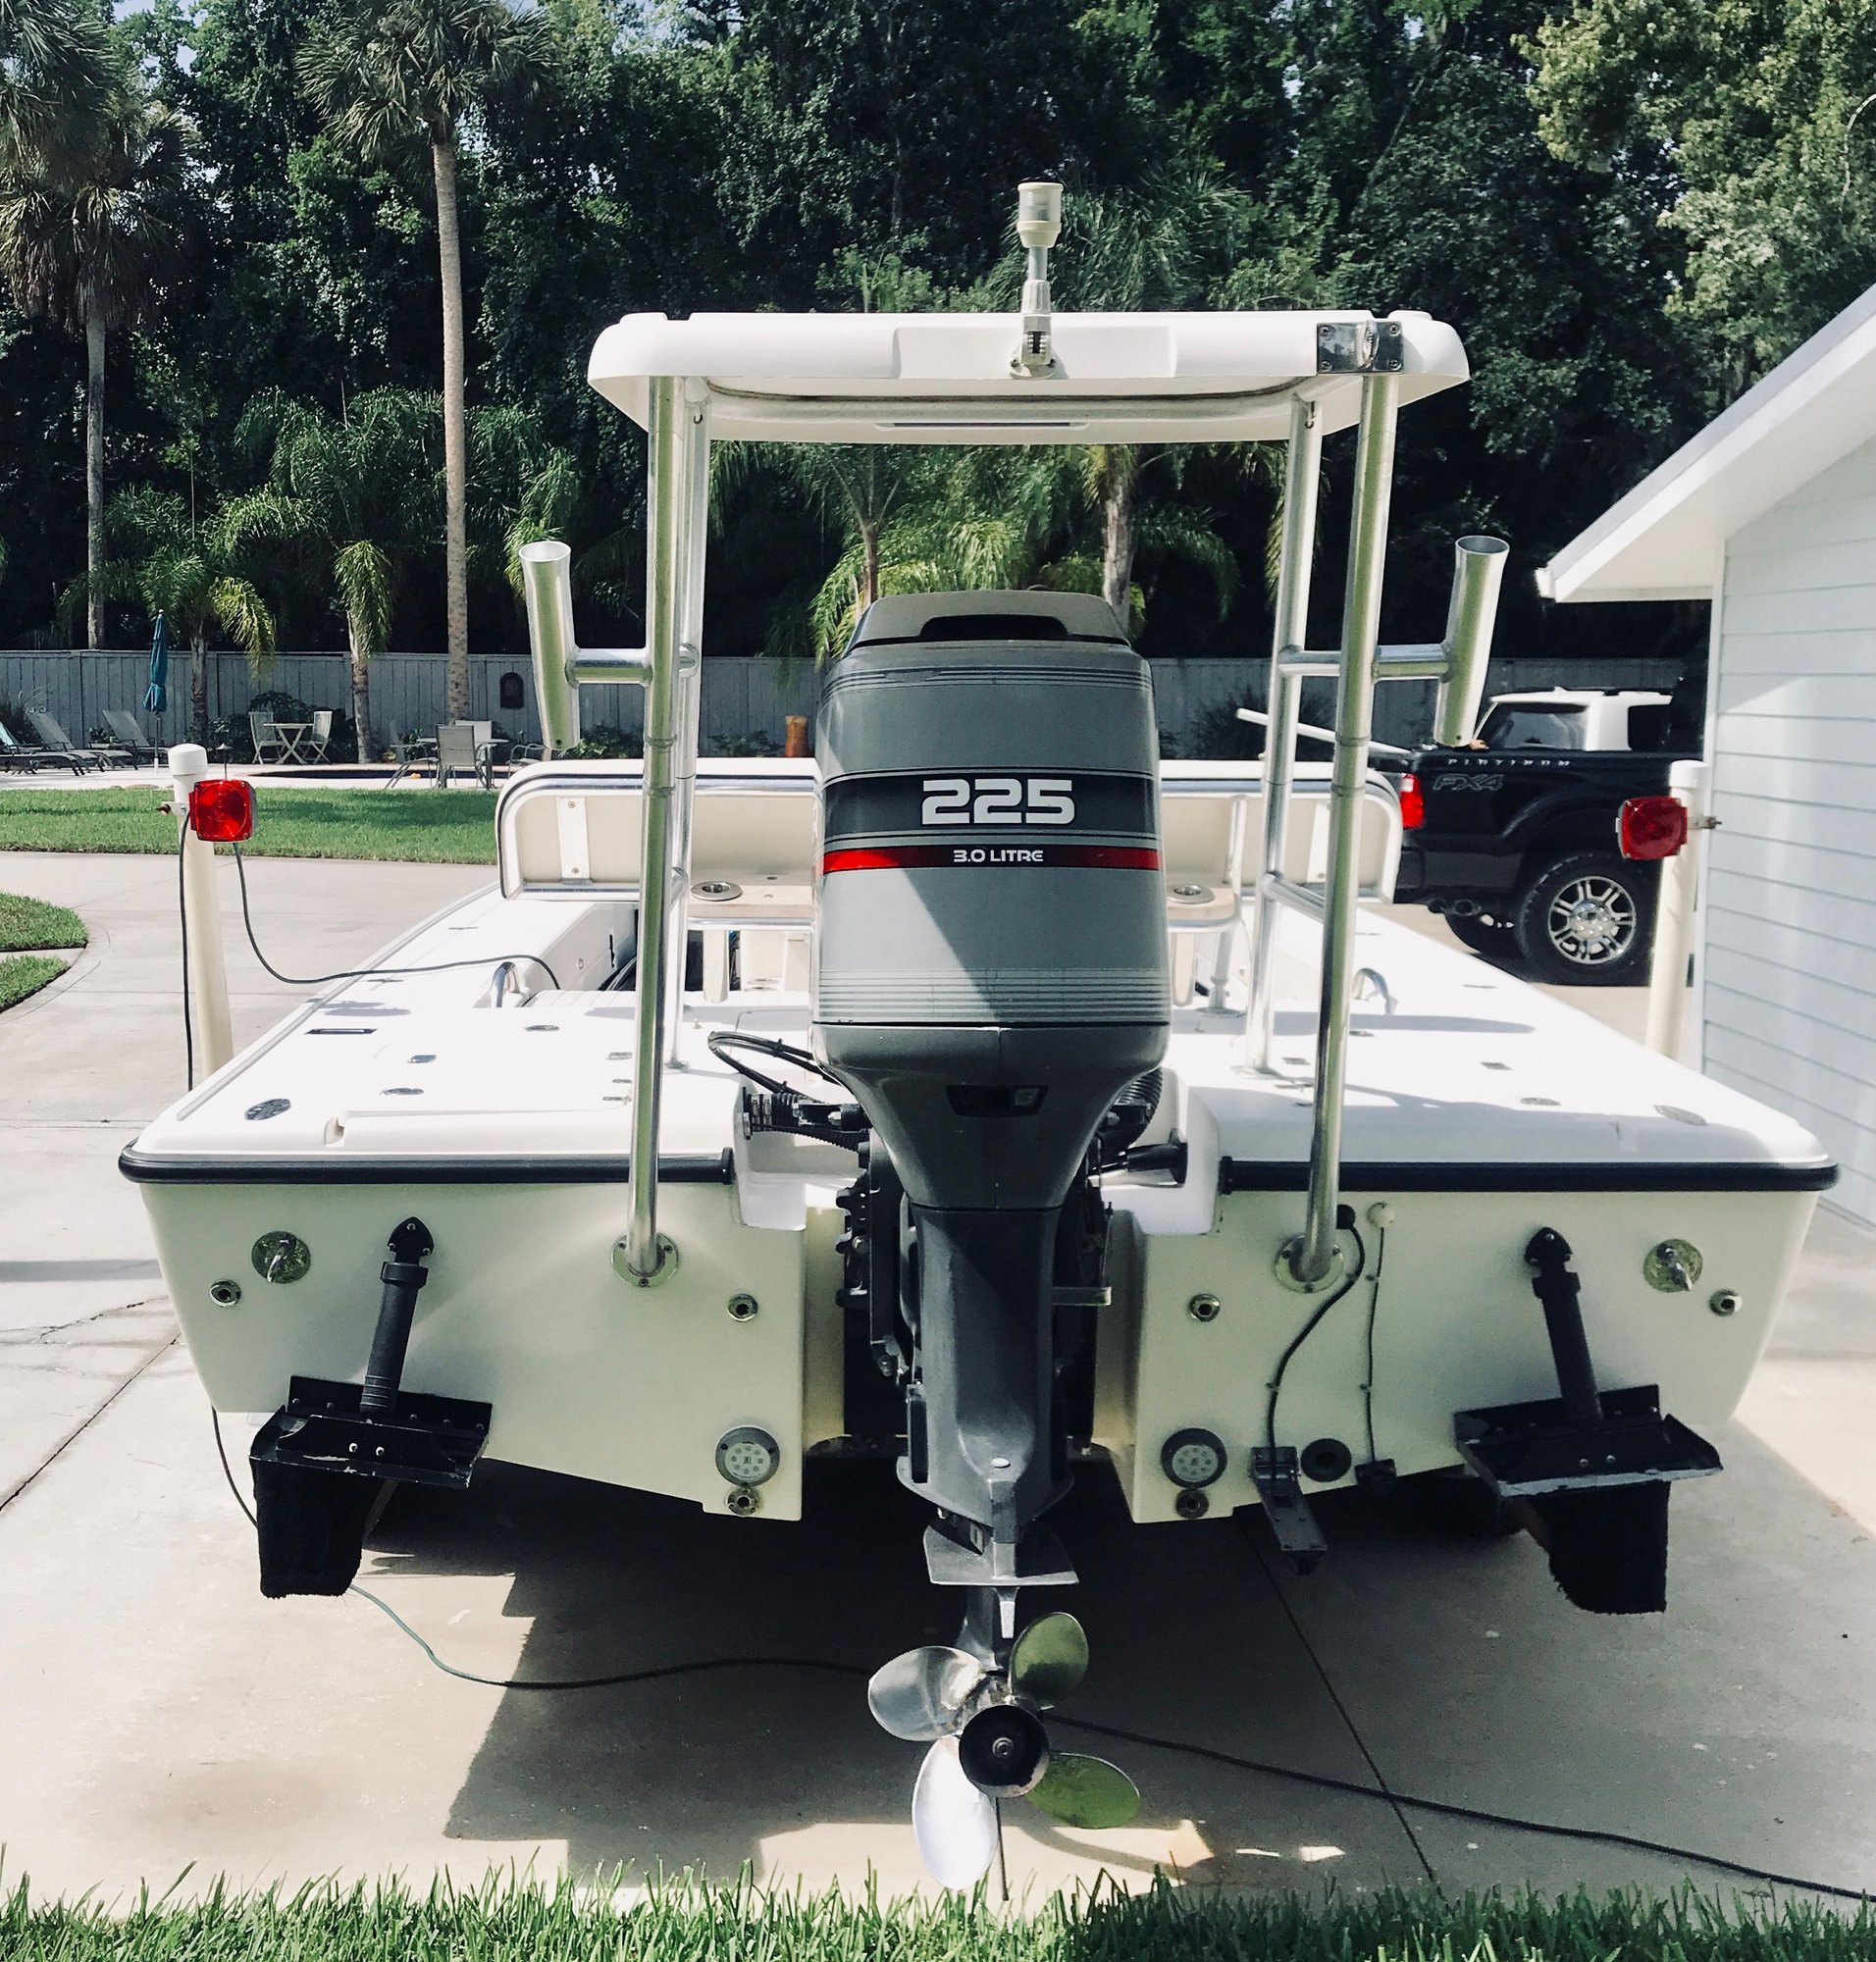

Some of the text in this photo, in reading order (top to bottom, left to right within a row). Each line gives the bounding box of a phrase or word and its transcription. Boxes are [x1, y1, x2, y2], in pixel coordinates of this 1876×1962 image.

[1433, 773, 1504, 791] FX4
[922, 779, 1074, 824] 225
[953, 849, 1044, 863] 3.0 LITRE
